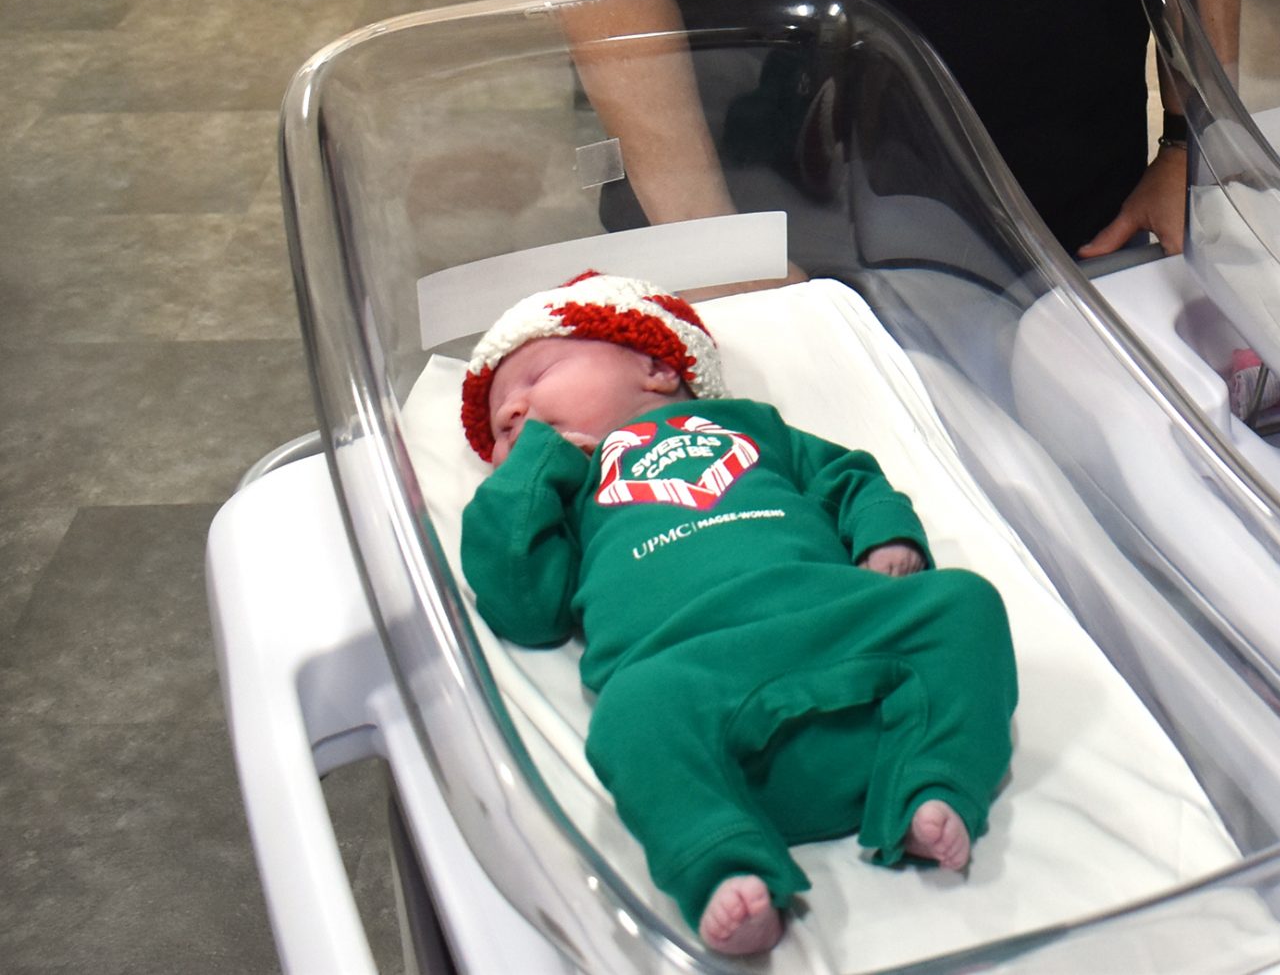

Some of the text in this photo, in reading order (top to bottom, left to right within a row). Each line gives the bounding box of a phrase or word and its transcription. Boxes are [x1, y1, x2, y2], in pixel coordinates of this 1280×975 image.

[631, 434, 722, 478] SWEET AS
[646, 446, 714, 479] CAN BE
[632, 508, 785, 560] UPMC MAGEE-WOMENS
